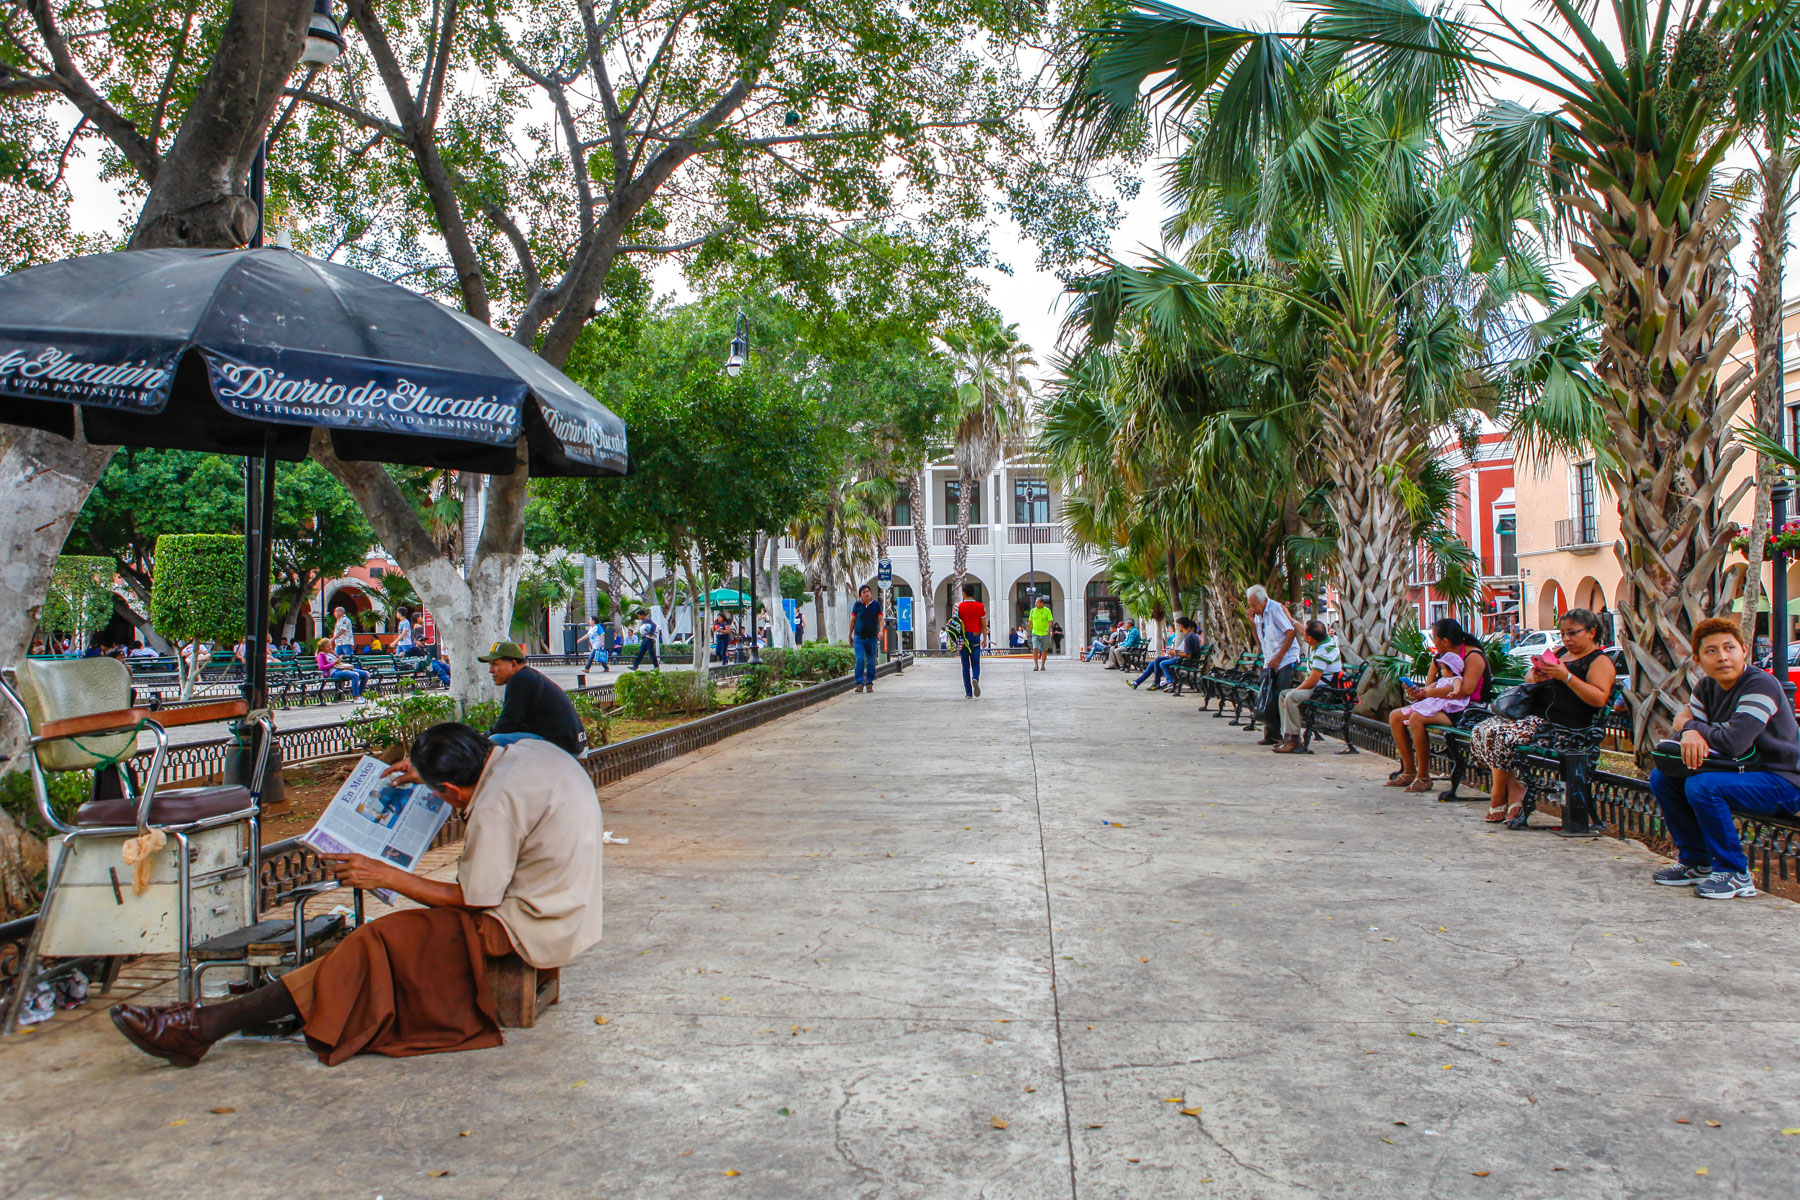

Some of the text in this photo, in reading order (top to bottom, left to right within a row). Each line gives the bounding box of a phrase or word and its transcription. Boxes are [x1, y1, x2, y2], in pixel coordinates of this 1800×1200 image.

[20, 347, 165, 389] Yucatán
[14, 378, 49, 390] VIDA
[53, 384, 149, 401] PENINSULAR
[220, 363, 517, 425] Diario de Yucatán
[232, 400, 513, 436] EL PERIODICO DE LA VIDA PENINSULAR
[341, 791, 355, 804] En
[350, 762, 374, 791] México
